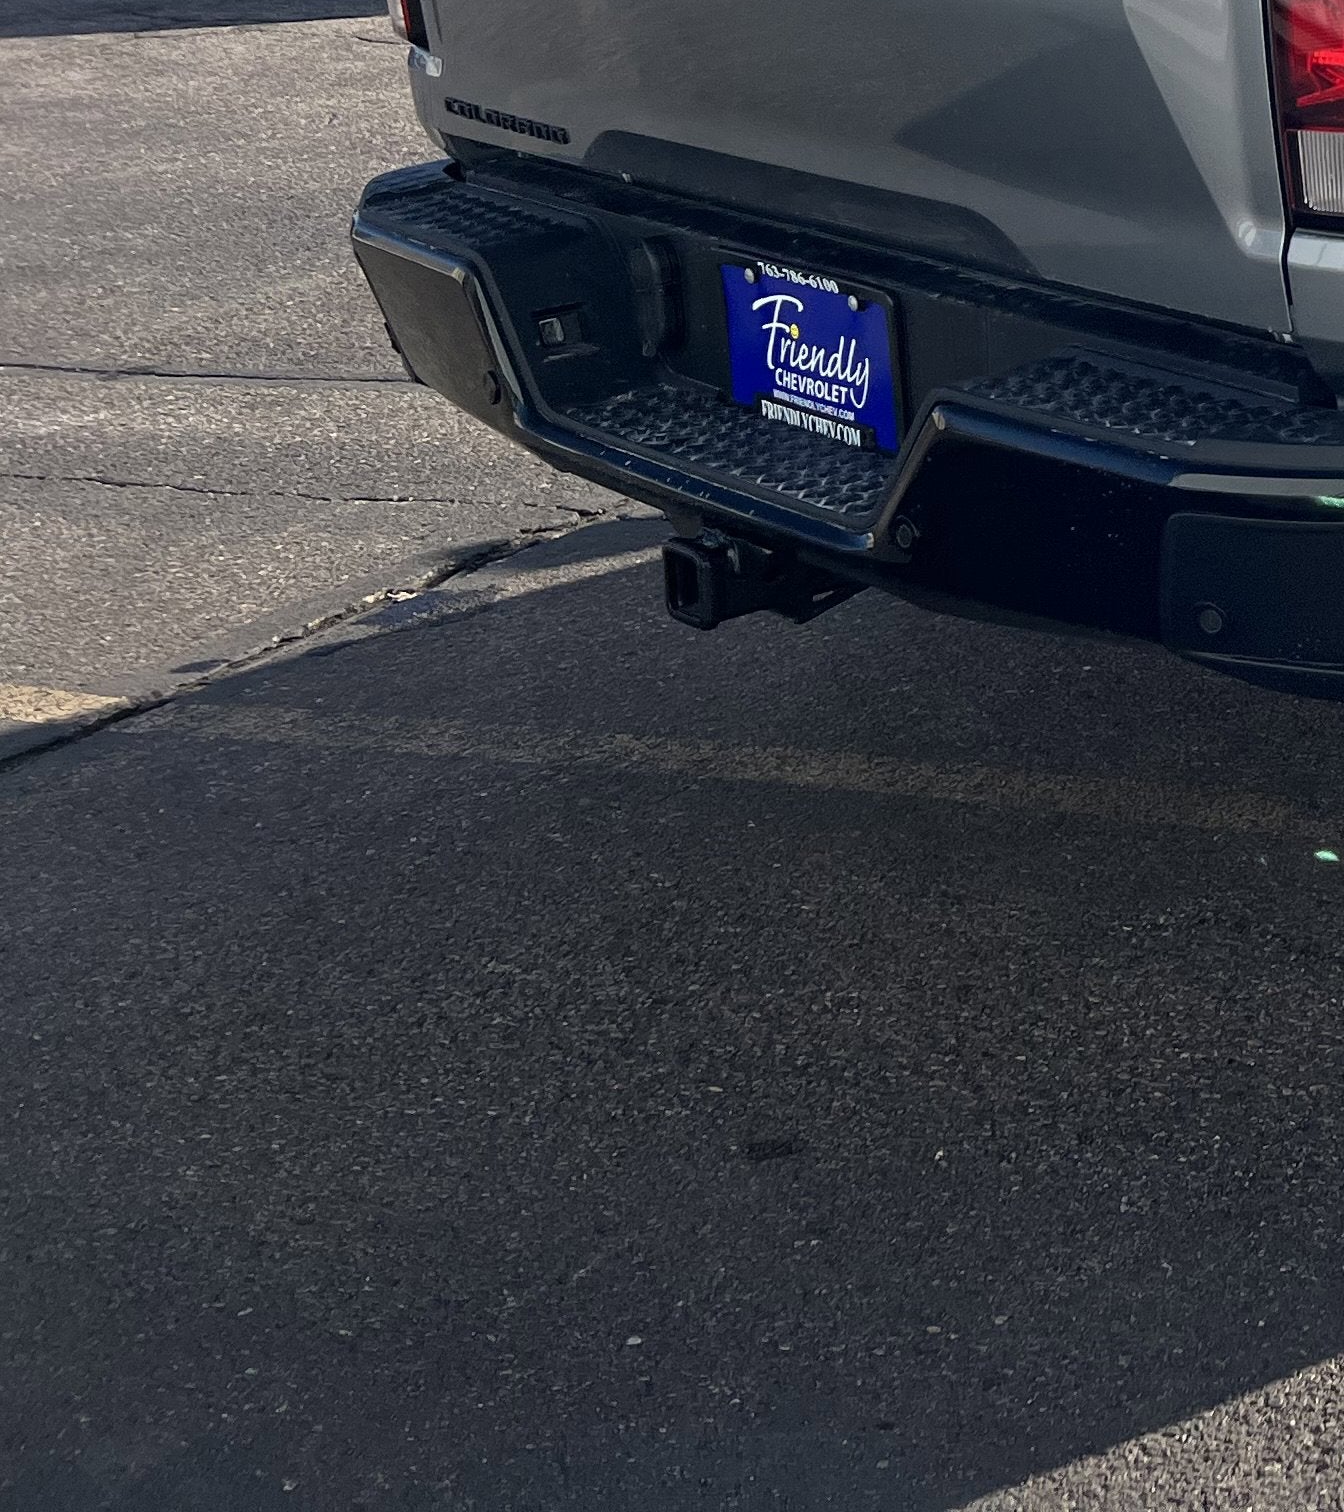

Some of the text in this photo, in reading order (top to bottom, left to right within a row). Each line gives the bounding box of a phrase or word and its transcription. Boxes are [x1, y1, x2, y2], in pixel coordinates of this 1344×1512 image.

[757, 261, 839, 294] 763-786-6100
[752, 294, 870, 409] Friendly
[775, 368, 849, 405] CHEVROLET
